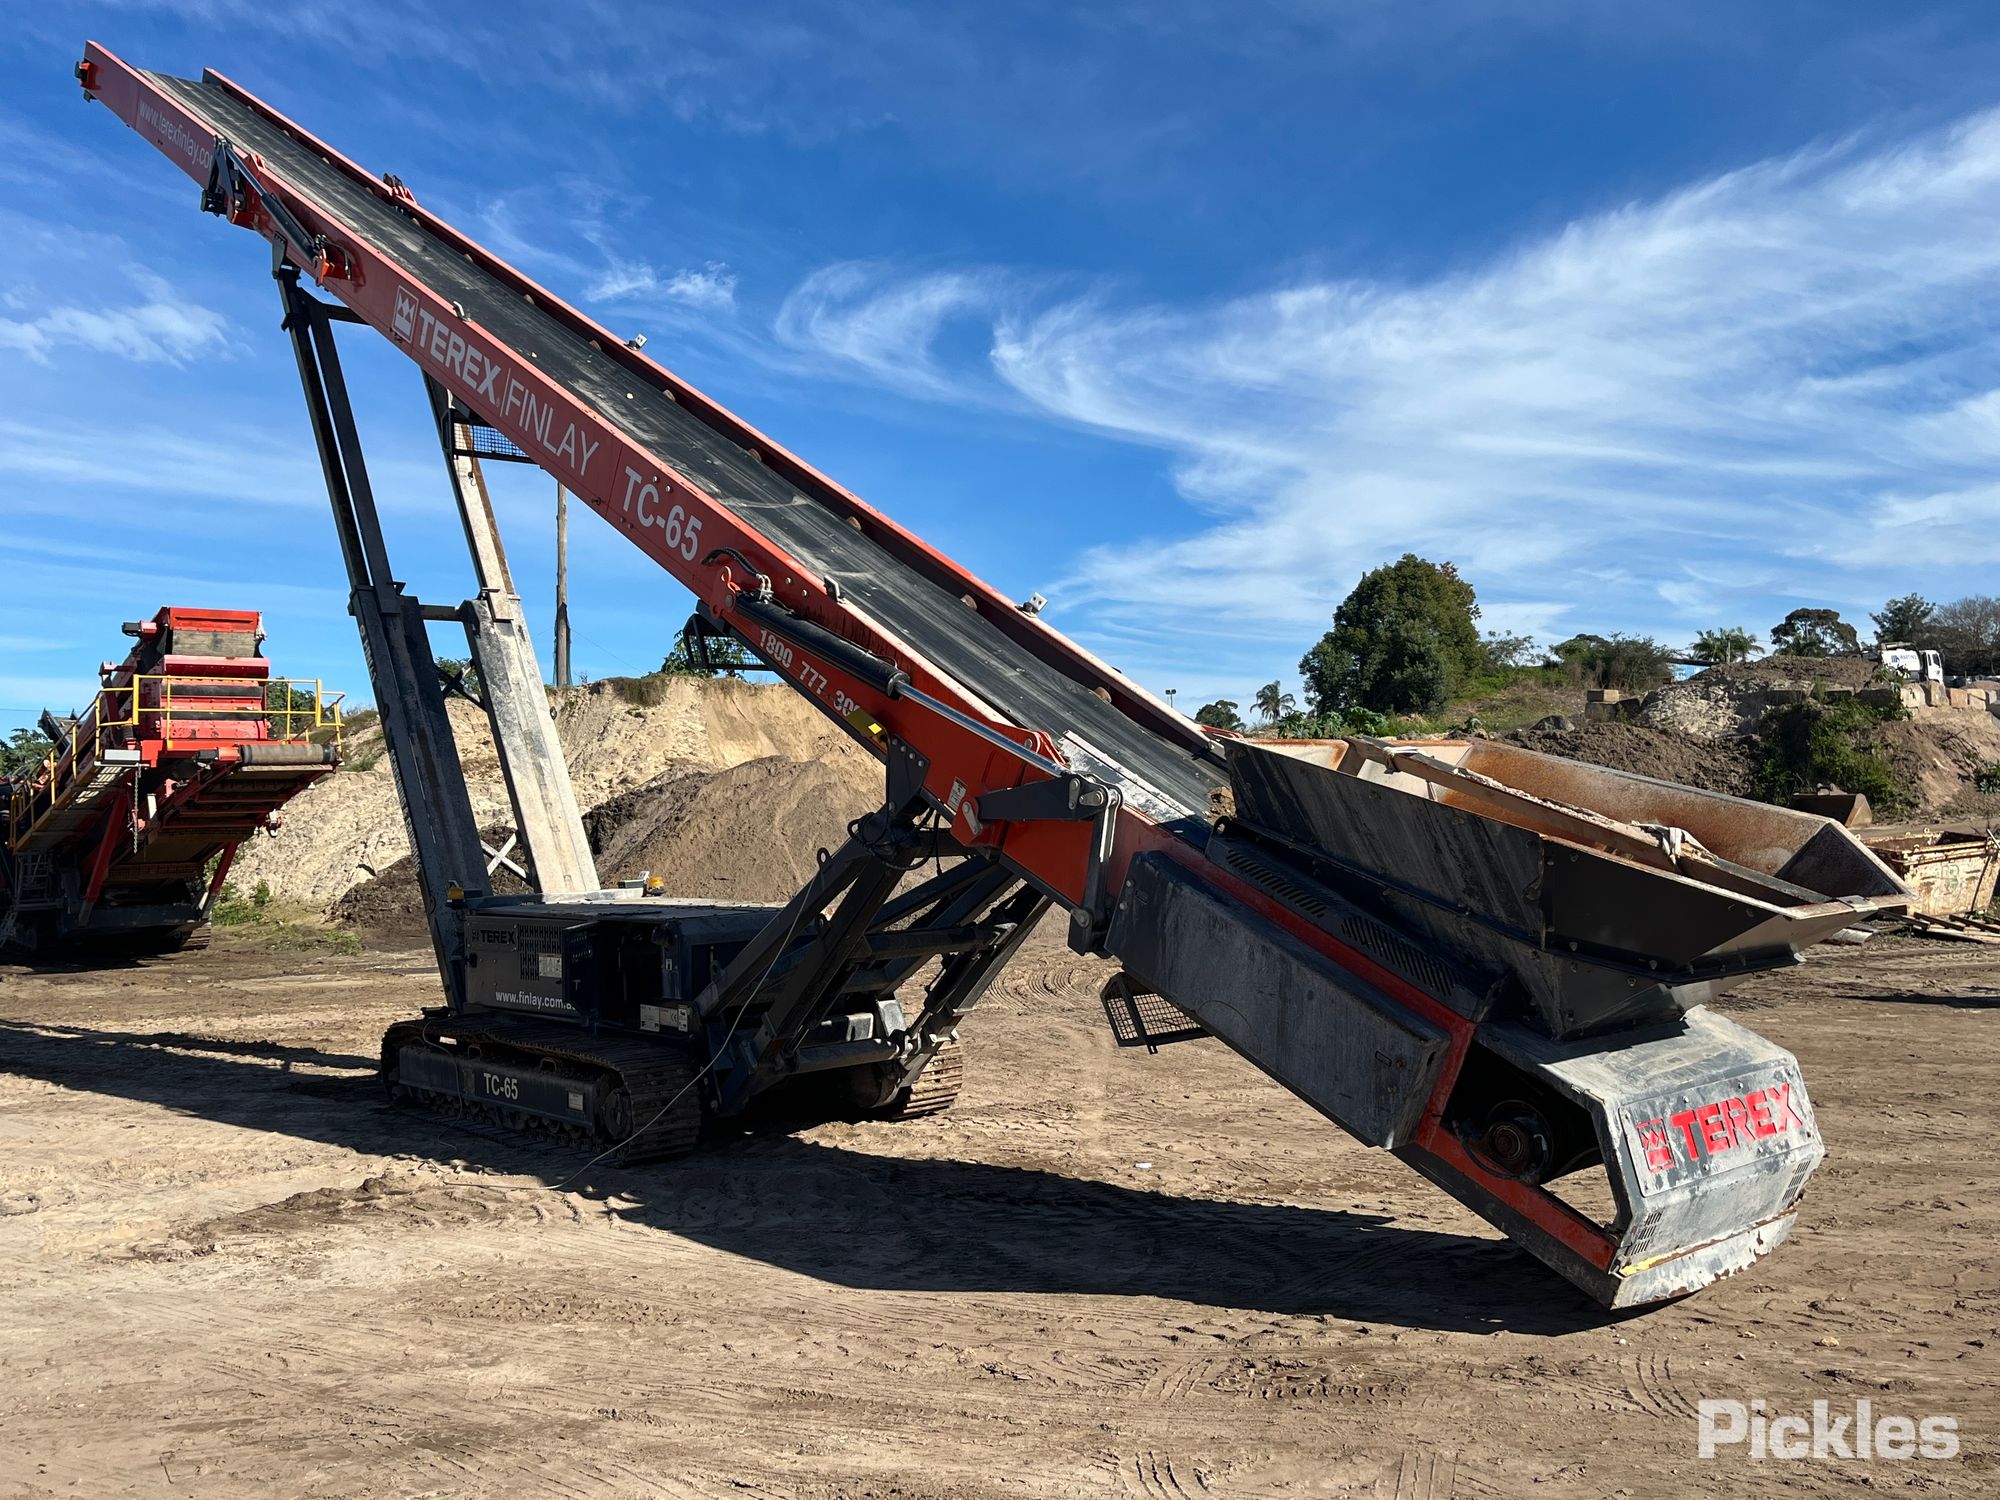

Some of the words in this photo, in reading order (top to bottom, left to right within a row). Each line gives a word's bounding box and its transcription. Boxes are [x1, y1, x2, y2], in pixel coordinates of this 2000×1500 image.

[418, 306, 502, 405] TEREX
[504, 377, 599, 476] FINLAY
[623, 465, 703, 561] TC-65
[760, 629, 793, 669] 1800
[799, 661, 828, 695] 777
[480, 929, 516, 946] TEREX
[495, 990, 577, 1011] www.finlay.com.a
[483, 1072, 519, 1100] TC-65
[1671, 1083, 1803, 1161] TEREX
